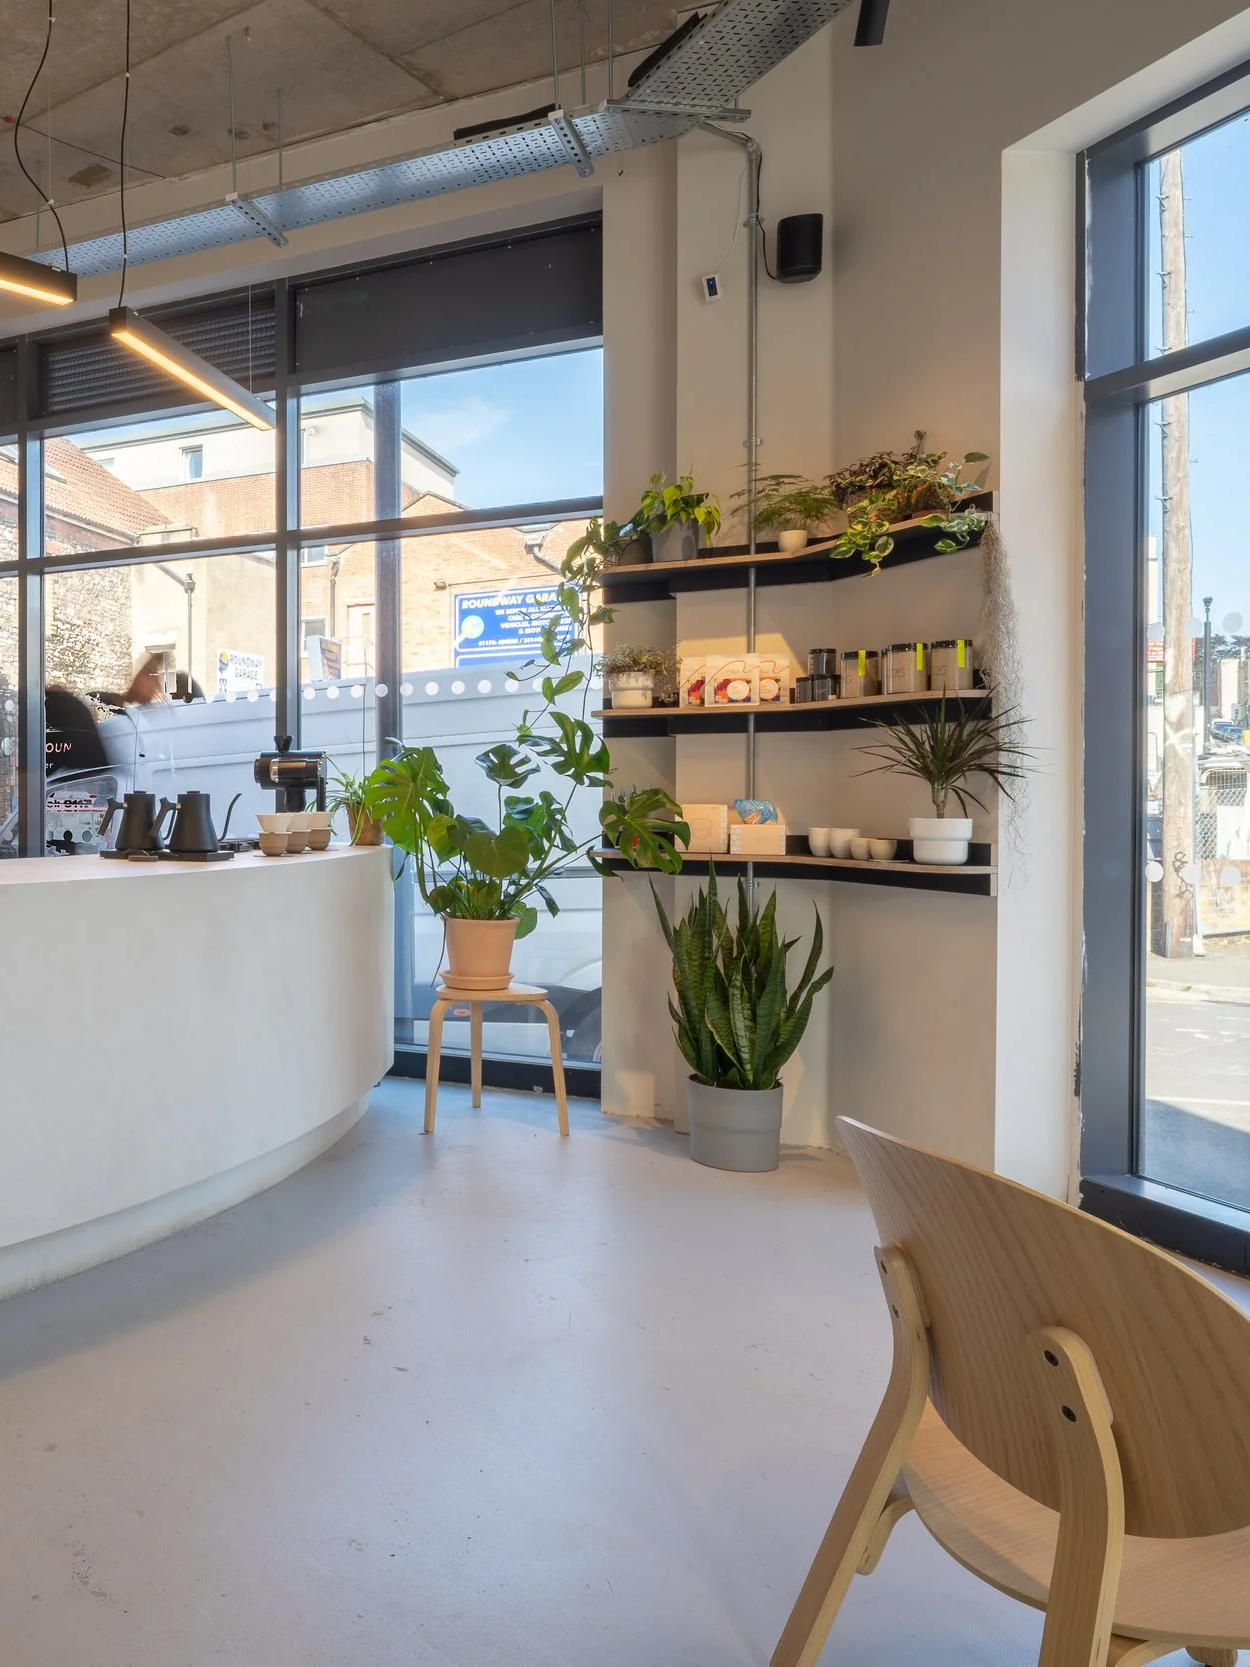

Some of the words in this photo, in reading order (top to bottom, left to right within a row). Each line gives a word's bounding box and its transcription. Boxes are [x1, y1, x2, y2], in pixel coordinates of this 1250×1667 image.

[462, 595, 524, 609] ROUNDWAY
[230, 654, 263, 668] ROUNDWAY
[235, 667, 258, 680] GARAGE
